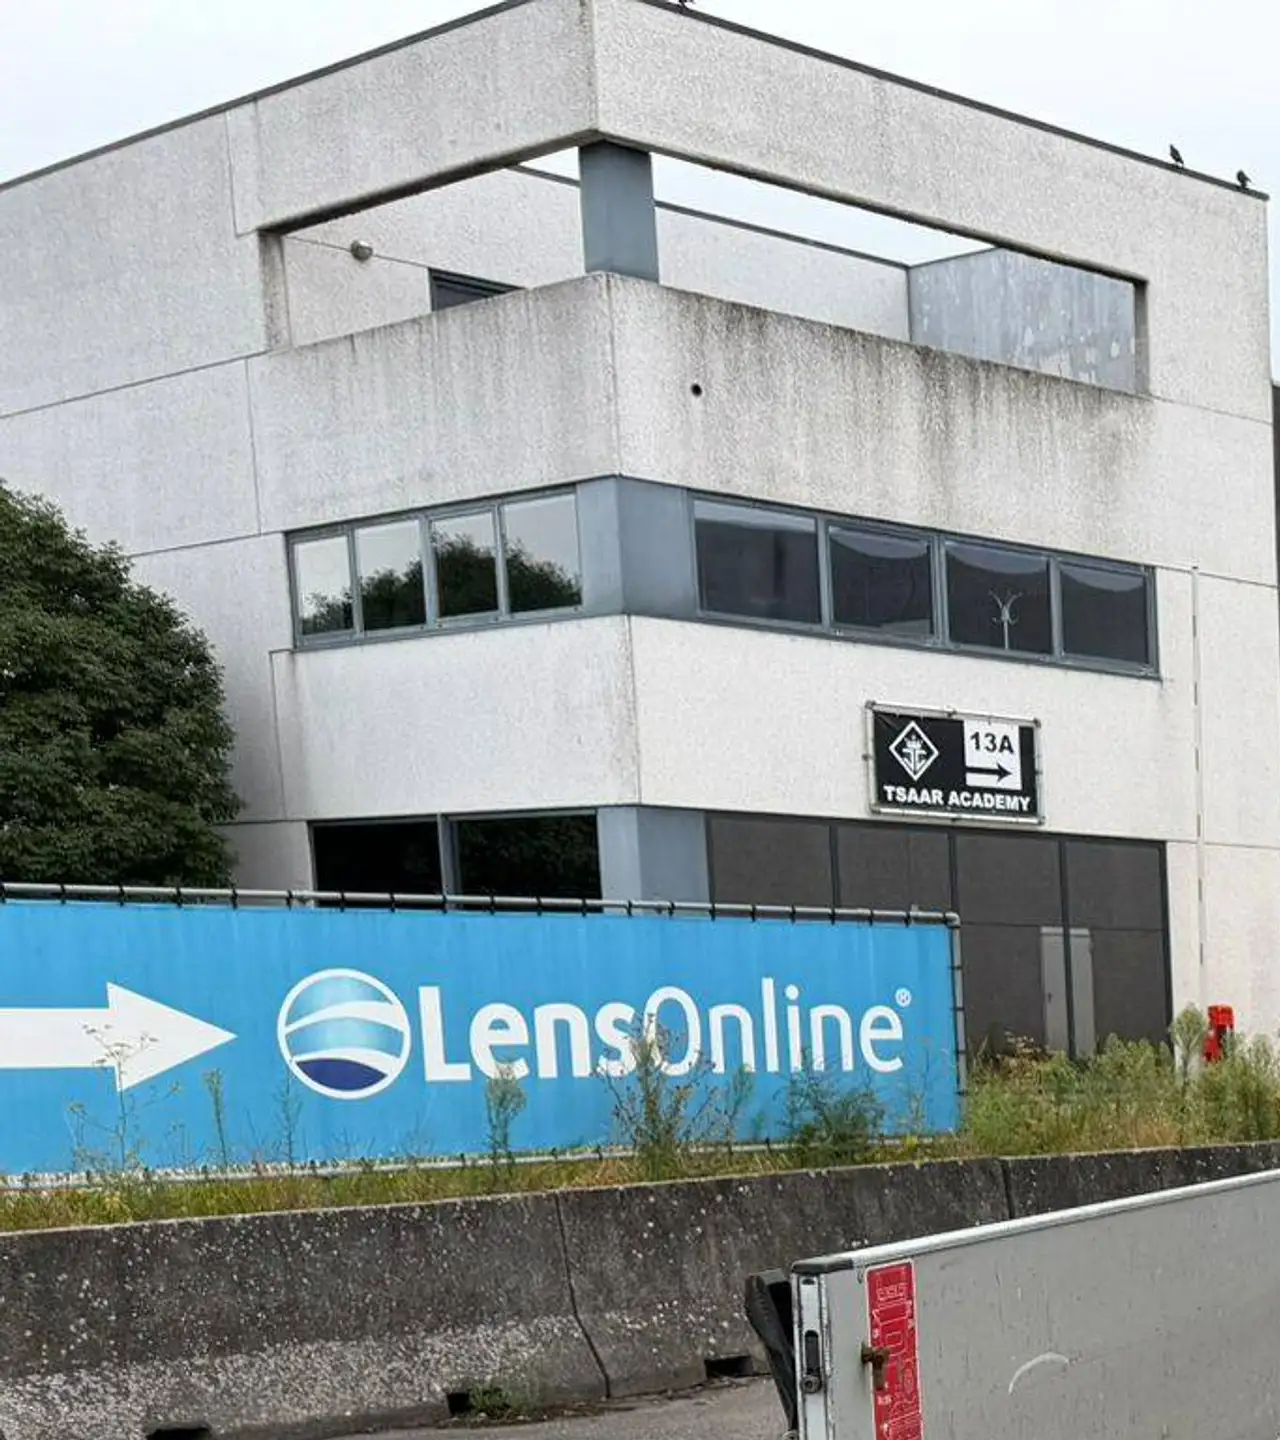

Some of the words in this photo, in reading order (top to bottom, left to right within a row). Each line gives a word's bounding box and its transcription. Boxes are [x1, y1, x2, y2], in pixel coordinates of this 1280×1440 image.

[969, 731, 1014, 755] 13A
[884, 785, 944, 805] TSAAR
[948, 790, 1031, 811] ACADEMY
